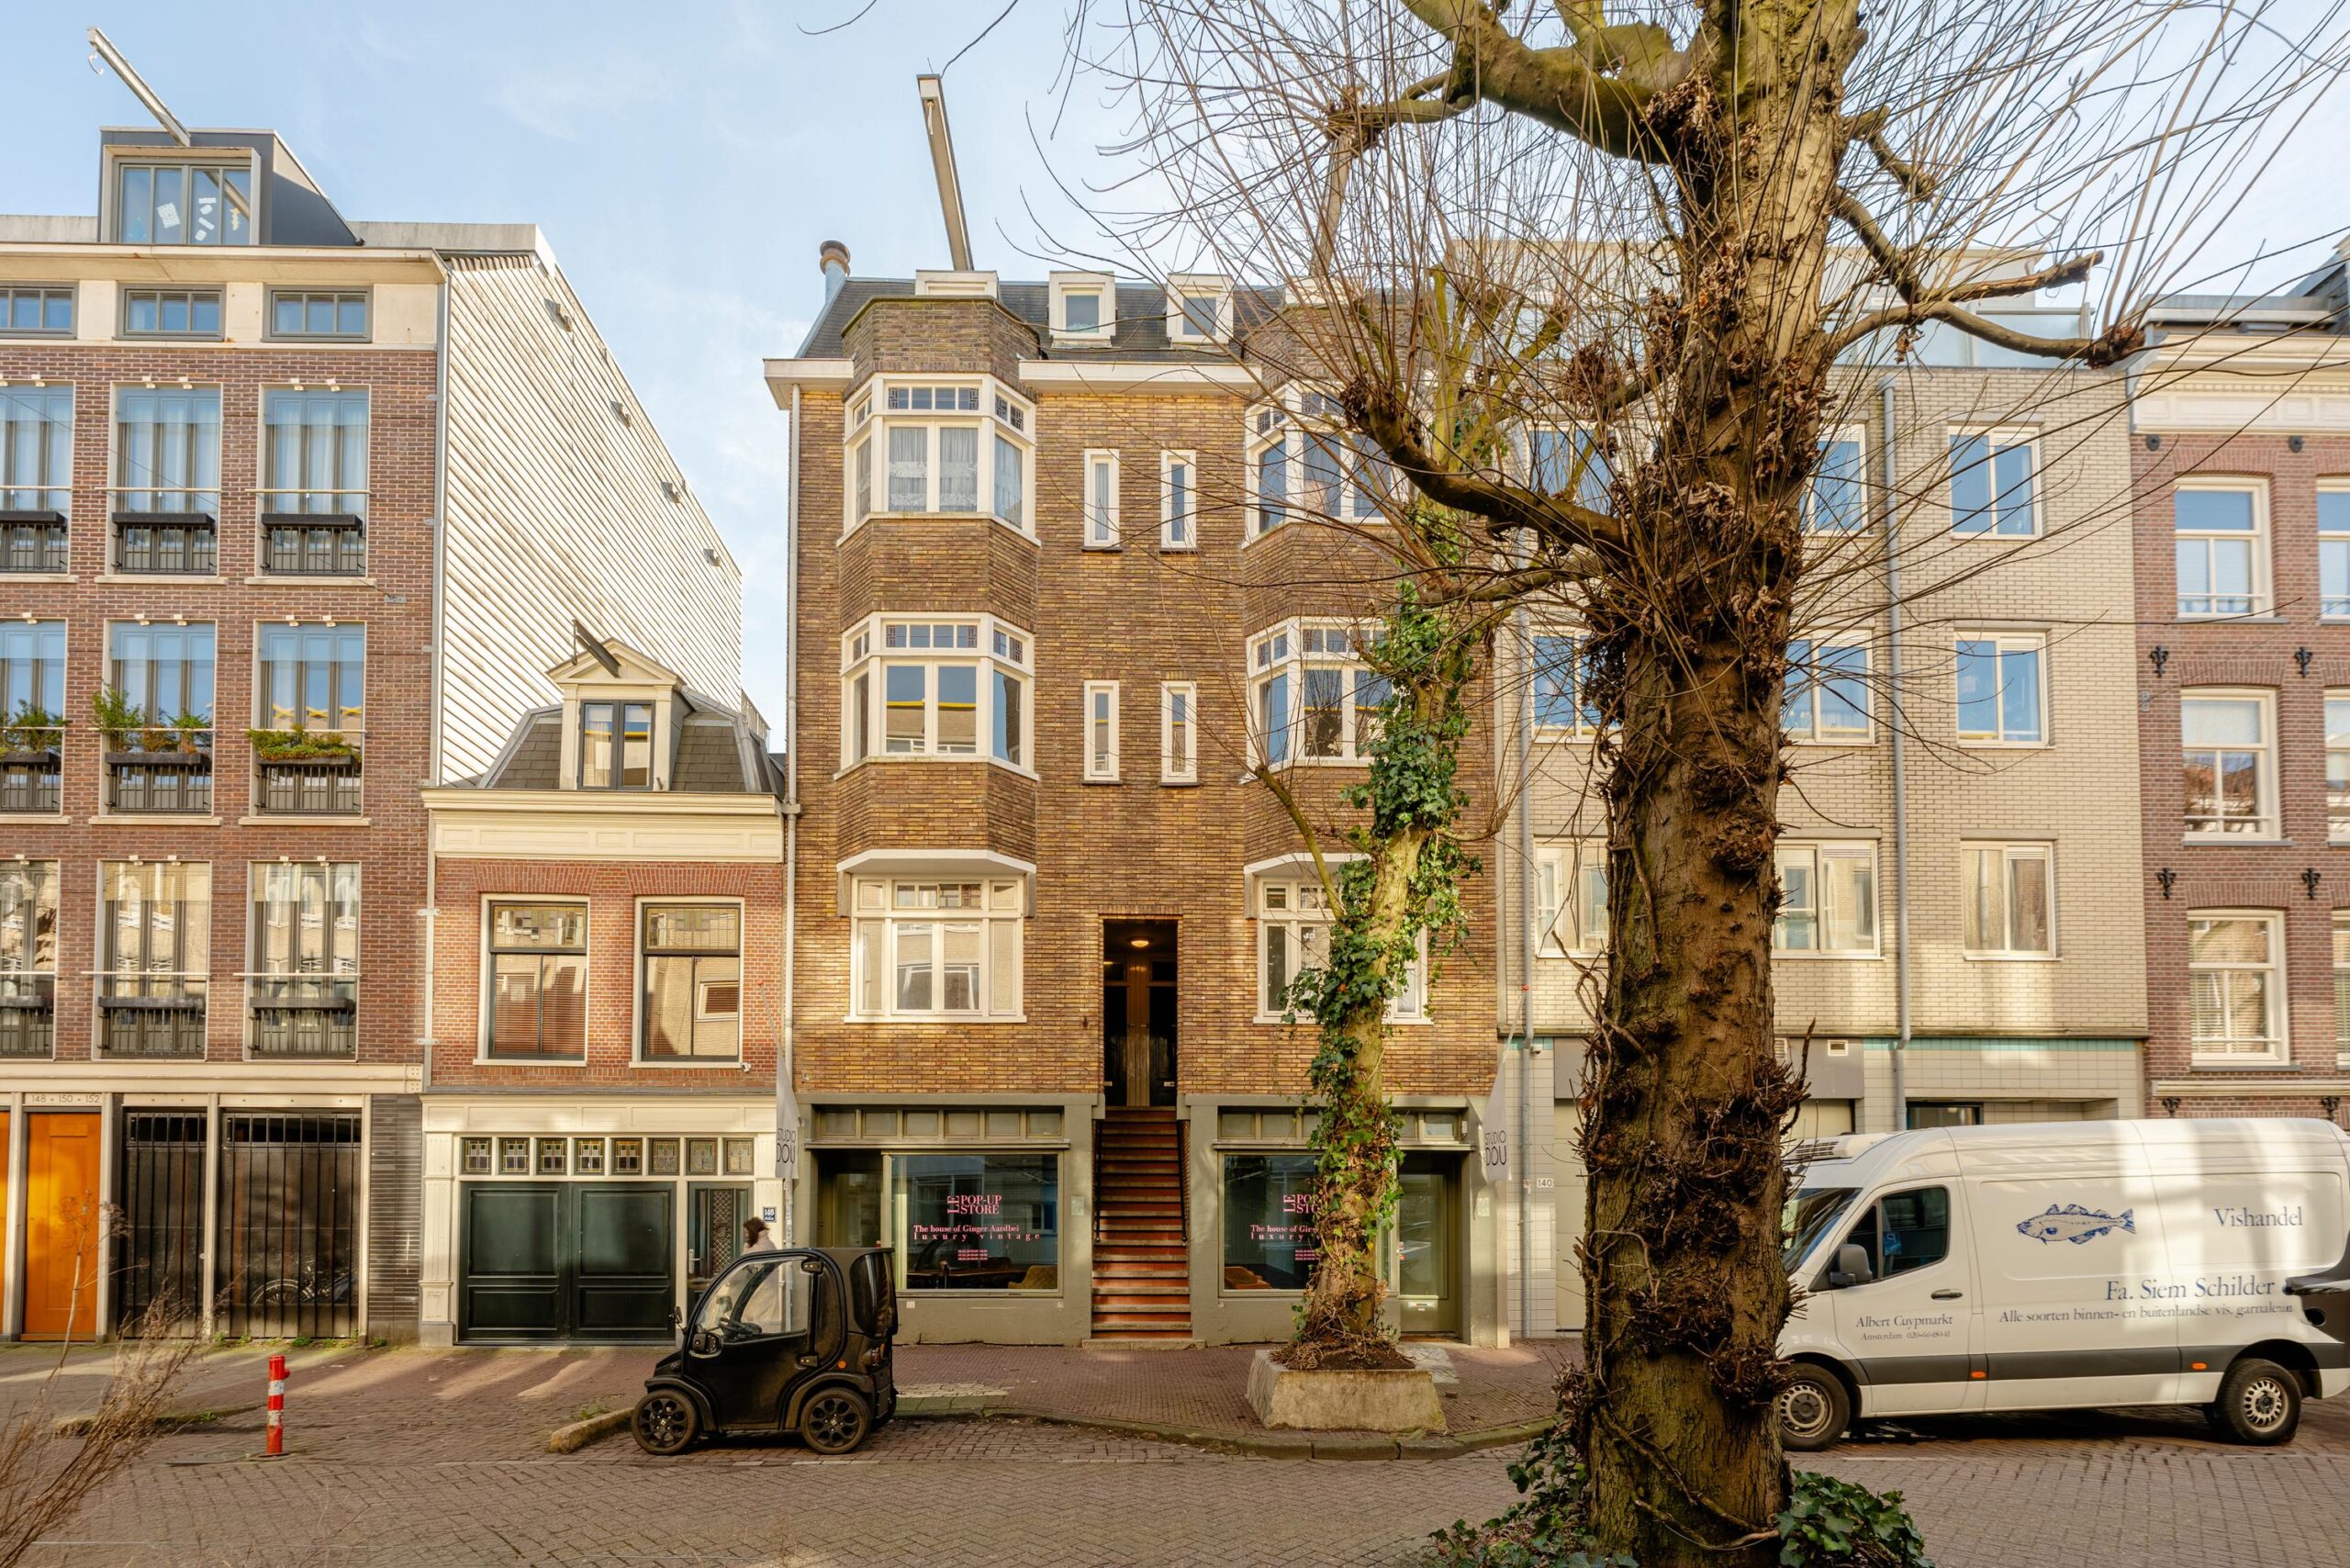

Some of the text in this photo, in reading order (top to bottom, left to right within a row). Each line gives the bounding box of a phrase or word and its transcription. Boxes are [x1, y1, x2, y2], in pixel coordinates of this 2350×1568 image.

[31, 1094, 100, 1103] 148 150 152
[778, 1127, 796, 1143] STUDIO
[1484, 1130, 1506, 1146] STUDIO
[776, 1143, 796, 1164] DOU
[1485, 1145, 1507, 1166] DOU
[1538, 1179, 1552, 1187] 140
[960, 1194, 1002, 1205] POP-UP
[960, 1204, 1000, 1215] STORE
[2212, 1205, 2303, 1227] Vishandel
[913, 1225, 1020, 1234] The house of Ginger Aardbei
[1250, 1225, 1265, 1233] The
[1267, 1225, 1288, 1233] house
[1289, 1225, 1297, 1233] of
[913, 1233, 1041, 1242] luxury vintage
[1250, 1232, 1304, 1242] luxury
[2106, 1275, 2276, 1301] Fa. Siem Schilder
[1999, 1310, 2023, 1323] Alle
[2026, 1311, 2070, 1322] soorten
[2073, 1308, 2119, 1321] binnen-
[2121, 1310, 2136, 1319] en
[2140, 1304, 2210, 1318] buitenlandse
[1856, 1314, 1953, 1329] Albert Cuypmarkt
[1861, 1332, 1903, 1341] Amsterdam
